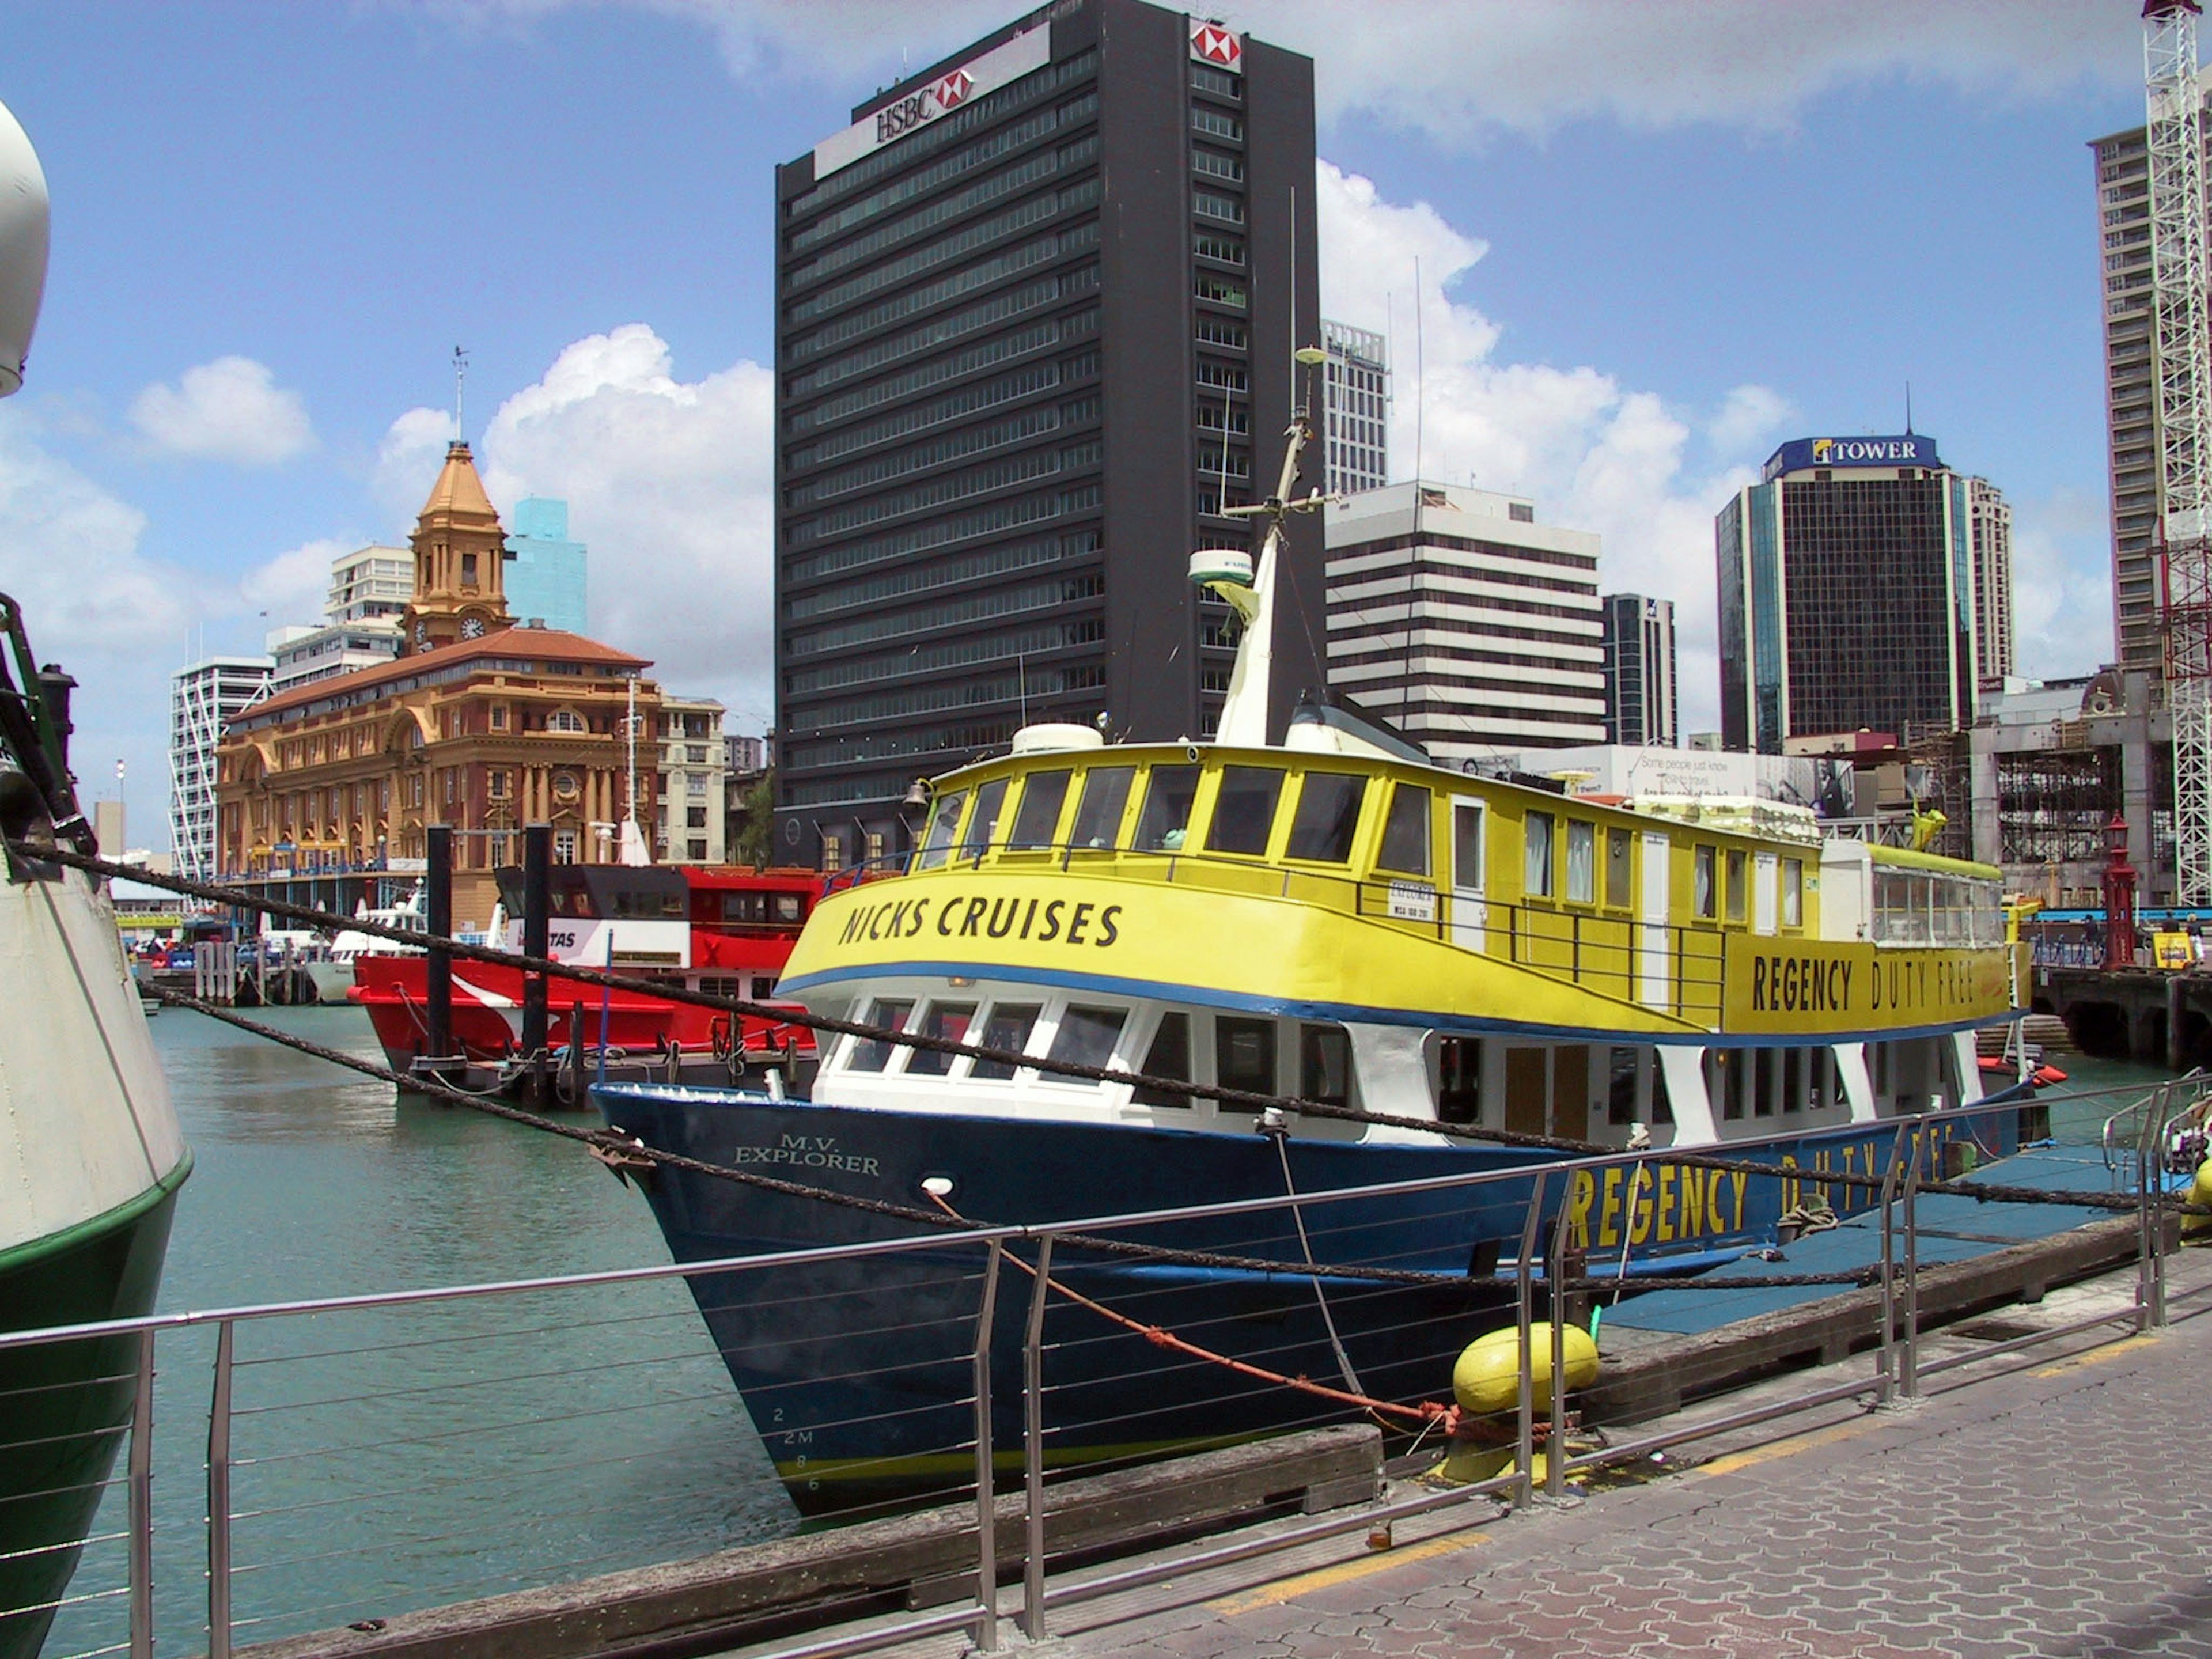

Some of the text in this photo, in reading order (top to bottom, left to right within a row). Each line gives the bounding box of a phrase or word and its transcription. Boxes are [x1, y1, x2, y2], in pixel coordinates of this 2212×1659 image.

[876, 88, 934, 143] HSBC
[1832, 441, 1917, 460] TOWER
[1641, 755, 1728, 773] Some people just know
[838, 897, 1123, 948] NICKS CRUISES
[549, 933, 575, 948] TAS
[1753, 956, 1973, 1012] REGENCY DUTY FREE
[781, 1133, 839, 1152] M.V.
[734, 1147, 880, 1177] EXPLORER
[1569, 1164, 1748, 1248] REGENCY
[1781, 1142, 1874, 1217] DUTY
[773, 1408, 784, 1422] 2
[796, 1455, 806, 1468] 8
[809, 1478, 820, 1491] 6
